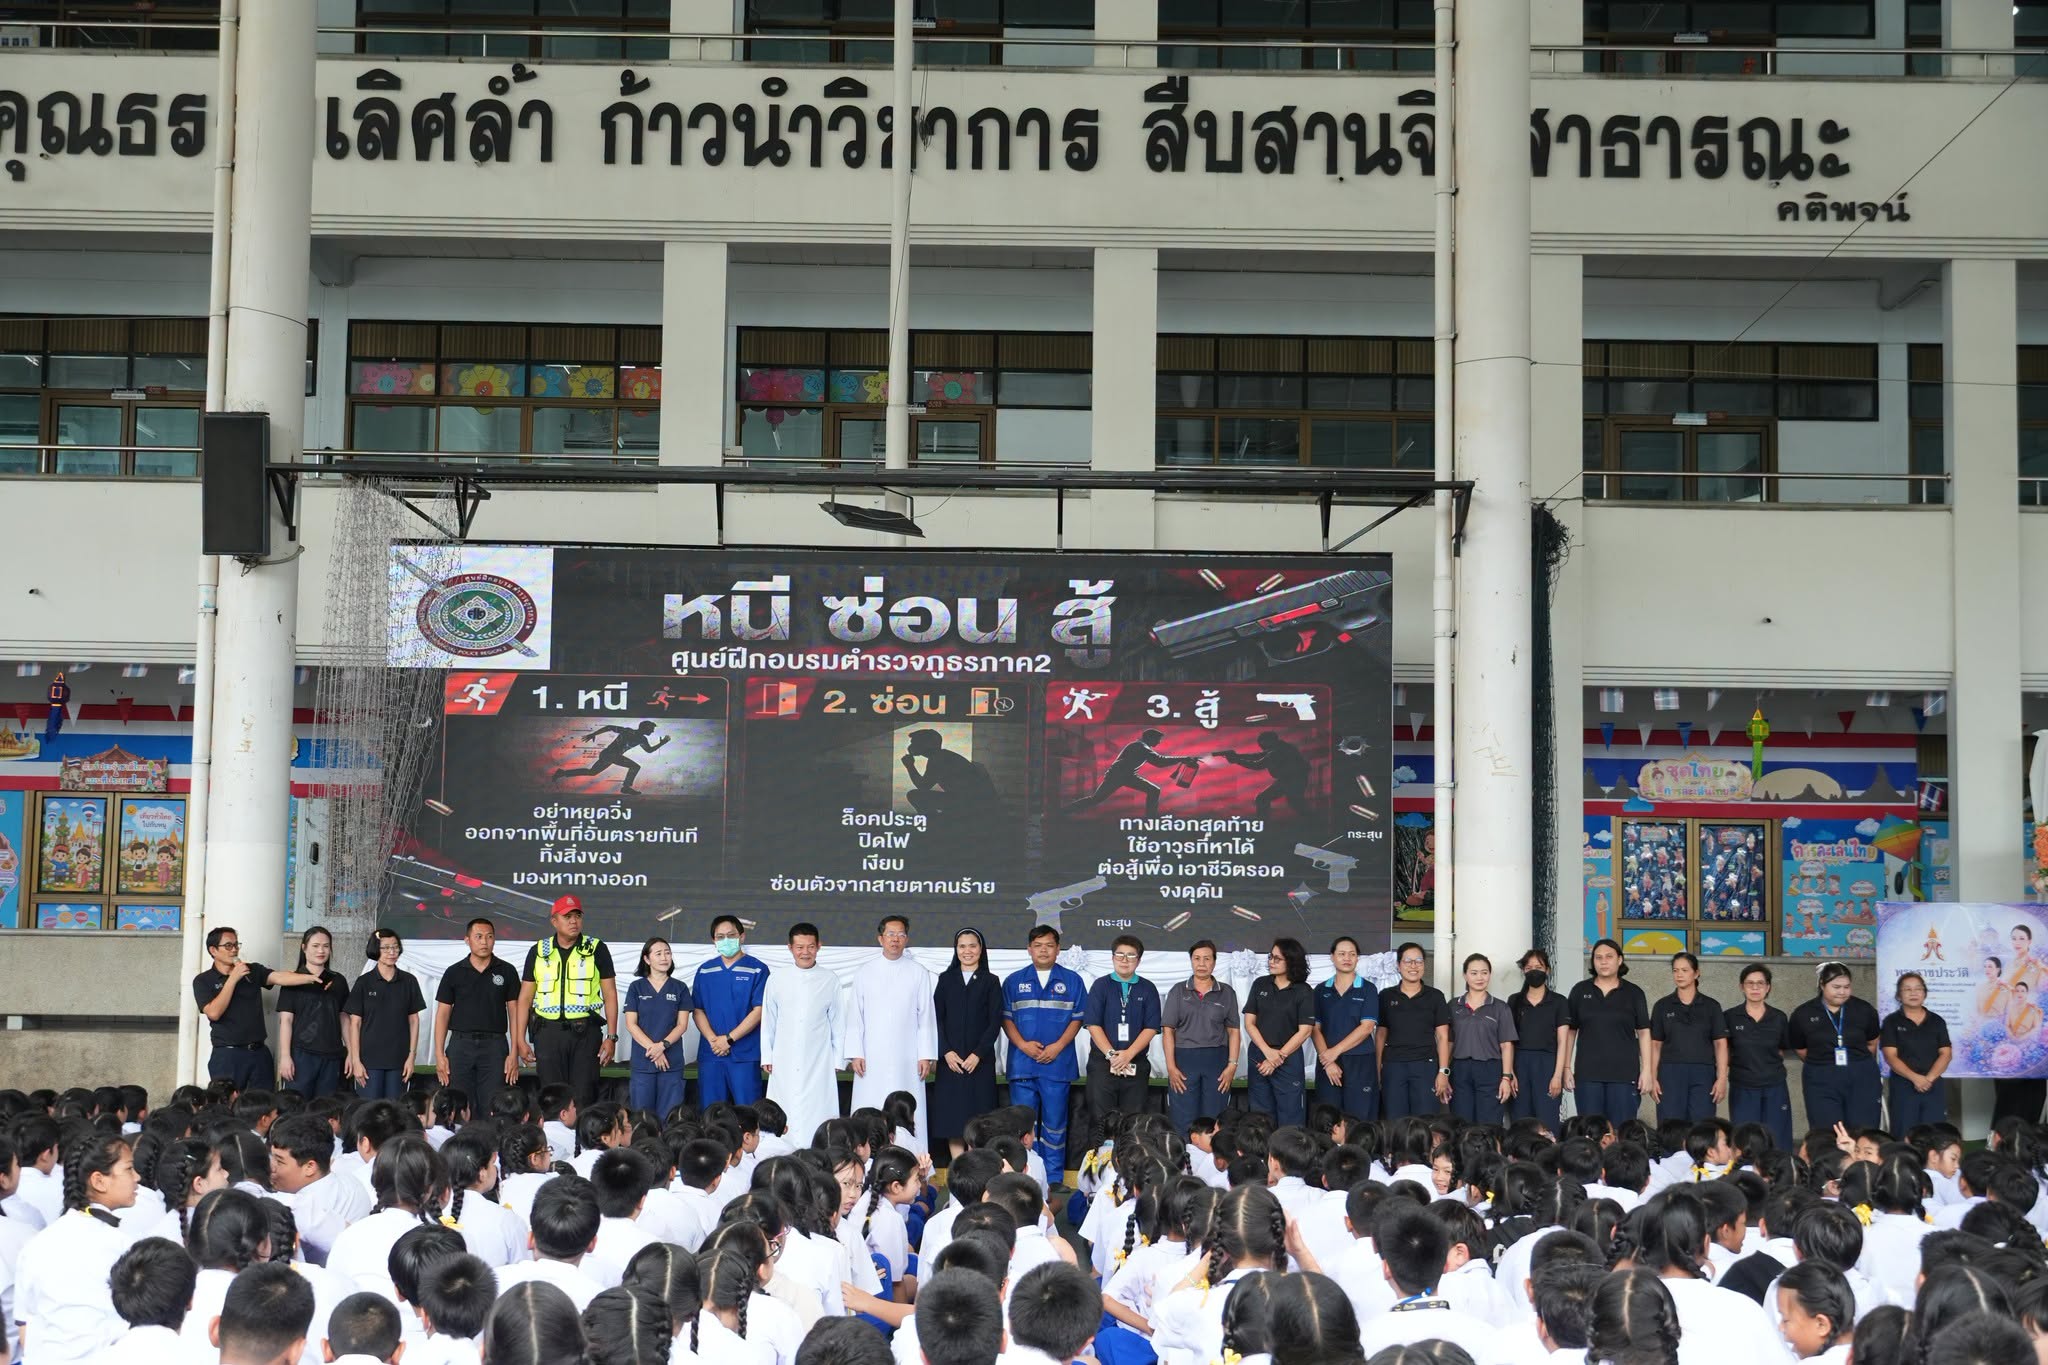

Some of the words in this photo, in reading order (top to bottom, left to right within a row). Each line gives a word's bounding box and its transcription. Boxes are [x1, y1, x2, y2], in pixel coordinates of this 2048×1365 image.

[1777, 192, 1911, 222] คติพจน์
[663, 574, 791, 640] หนี
[821, 575, 1018, 644] ซ่อน
[671, 646, 1051, 679] ศูนย์ฝึกอบรมตำรวจภูธรภาค2
[532, 686, 564, 709] 1.
[578, 682, 628, 710] หนี
[823, 690, 857, 714] 2.
[870, 686, 946, 715] ซ่อน
[1146, 694, 1181, 718] 3.
[1194, 689, 1221, 729] สู้
[1665, 761, 1725, 783] ชุดไทย
[533, 800, 632, 823] อย่าหยุดวิ่ง
[465, 820, 698, 844] ออกจากพื้นที่อันตรายทันที
[1119, 814, 1264, 838] ทางเลือกสุดท้าย
[1347, 830, 1383, 841] กระสุน
[858, 832, 911, 849] ปิดไฟ
[1127, 835, 1256, 859] ใช้อาวุธที่หาได้
[540, 844, 622, 865] ทิ้งสิ่งของ
[862, 853, 904, 871] เงียบ
[512, 871, 648, 887] มองหาทางออก
[1097, 857, 1174, 881] ต่อสู้เพื่อ
[1178, 861, 1285, 878] เอาชีวิตรอด
[769, 873, 996, 894] ซ่อนตัวจากสายตาคนร้าย
[1159, 883, 1223, 904] จงดุดัน
[1096, 917, 1132, 931] กระสุน
